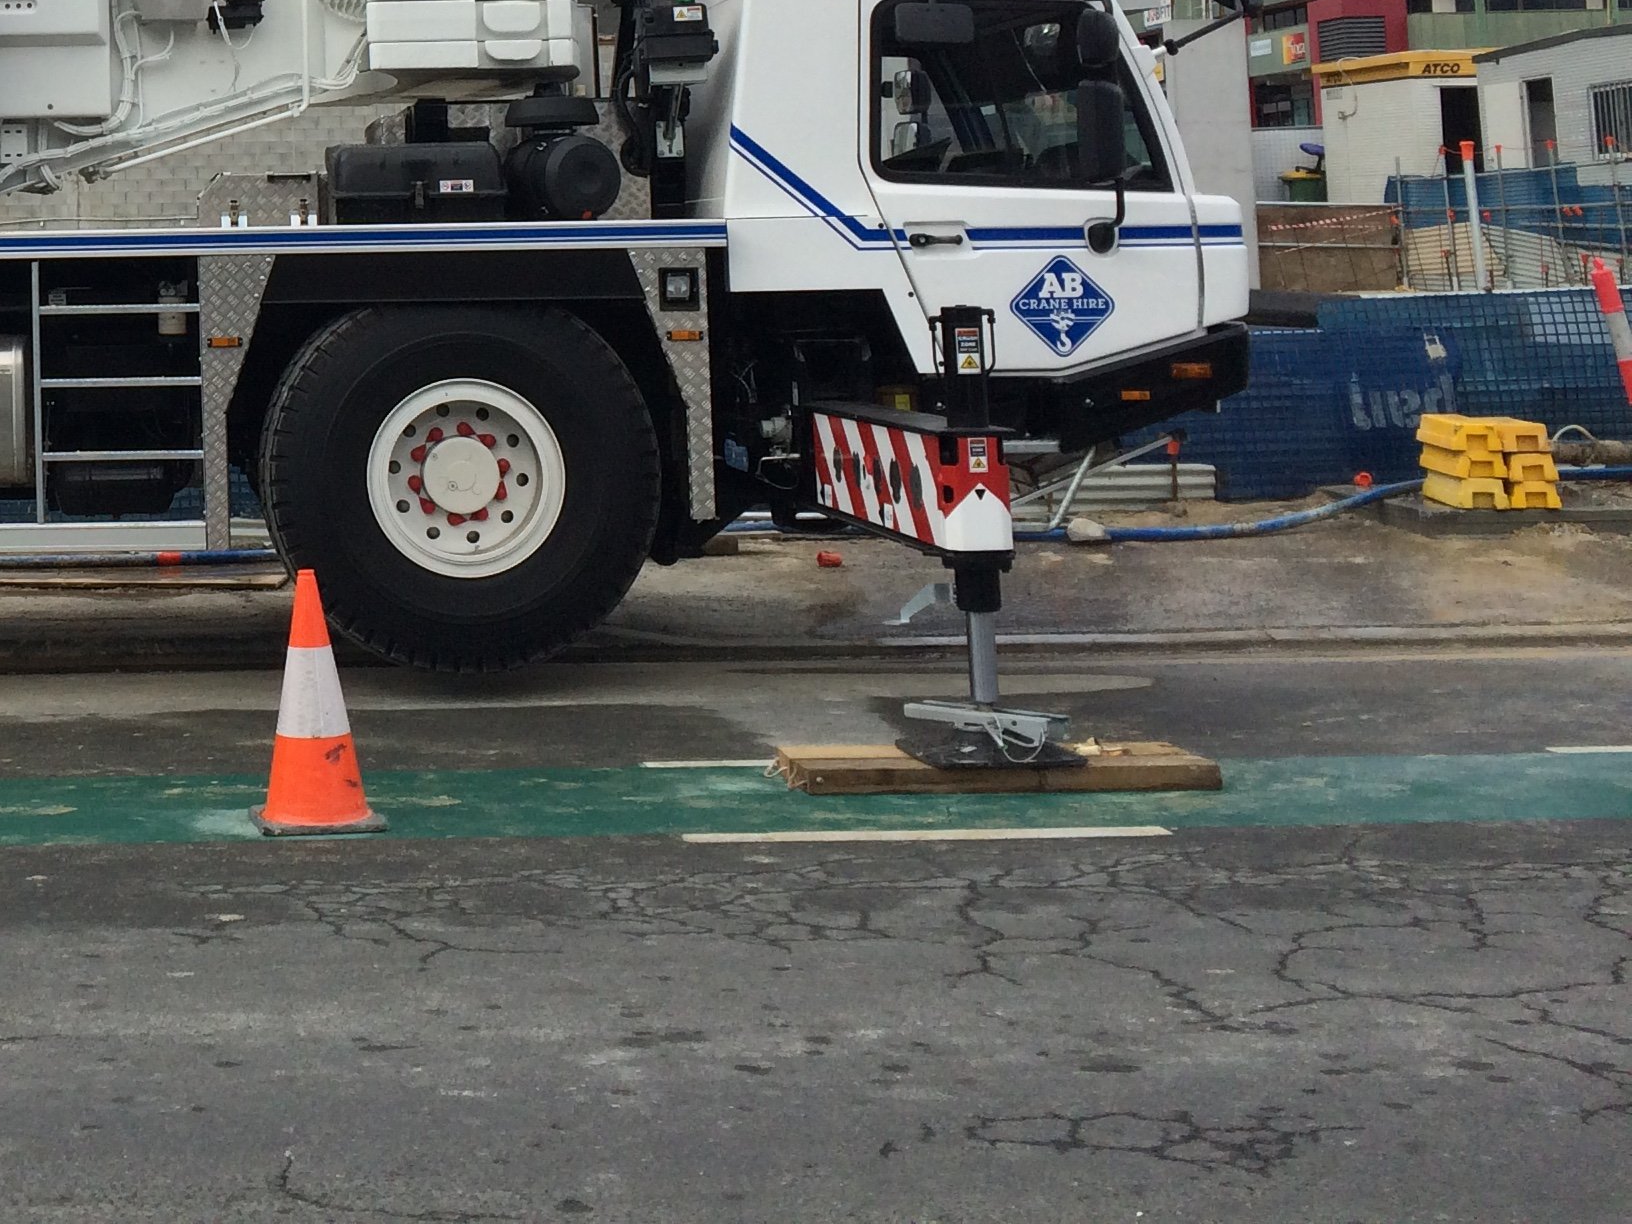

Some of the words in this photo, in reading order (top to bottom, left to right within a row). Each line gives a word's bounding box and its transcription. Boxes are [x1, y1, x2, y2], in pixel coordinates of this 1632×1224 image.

[1422, 63, 1461, 74] ATCO
[1038, 272, 1084, 298] AB
[1019, 299, 1068, 309] CRANE
[1073, 298, 1106, 309] HIRE
